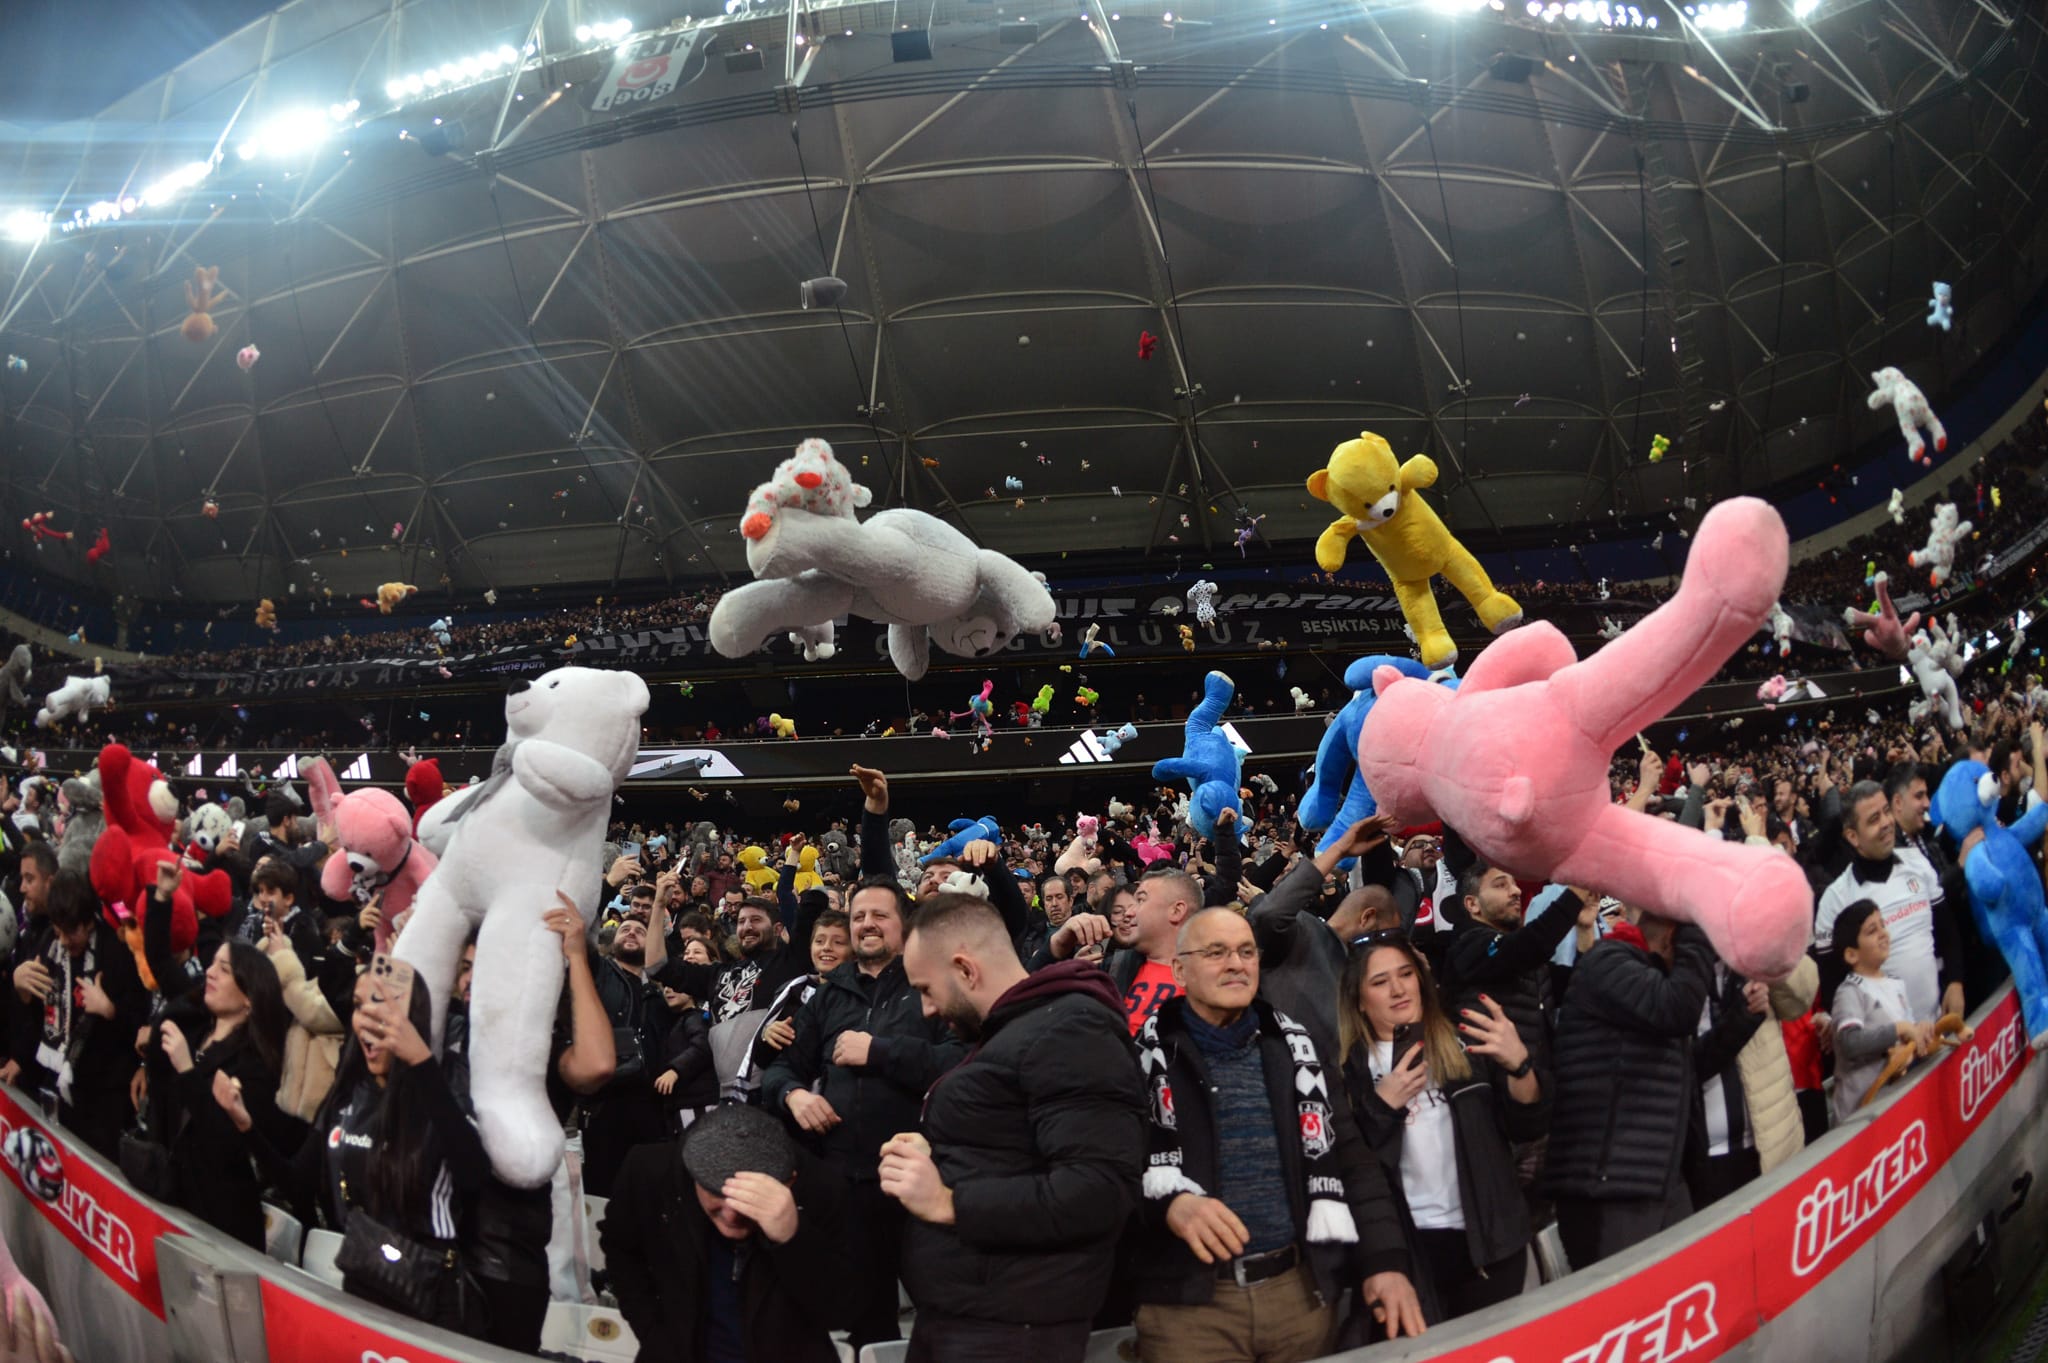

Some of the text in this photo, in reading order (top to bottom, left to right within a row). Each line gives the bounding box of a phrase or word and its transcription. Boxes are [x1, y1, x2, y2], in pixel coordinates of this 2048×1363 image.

[1301, 617, 1402, 635] BEŞİKTAŞ JK
[57, 1177, 140, 1283] LKER
[1792, 1120, 1928, 1276] ÜLKER
[1562, 1281, 1719, 1363] KER
